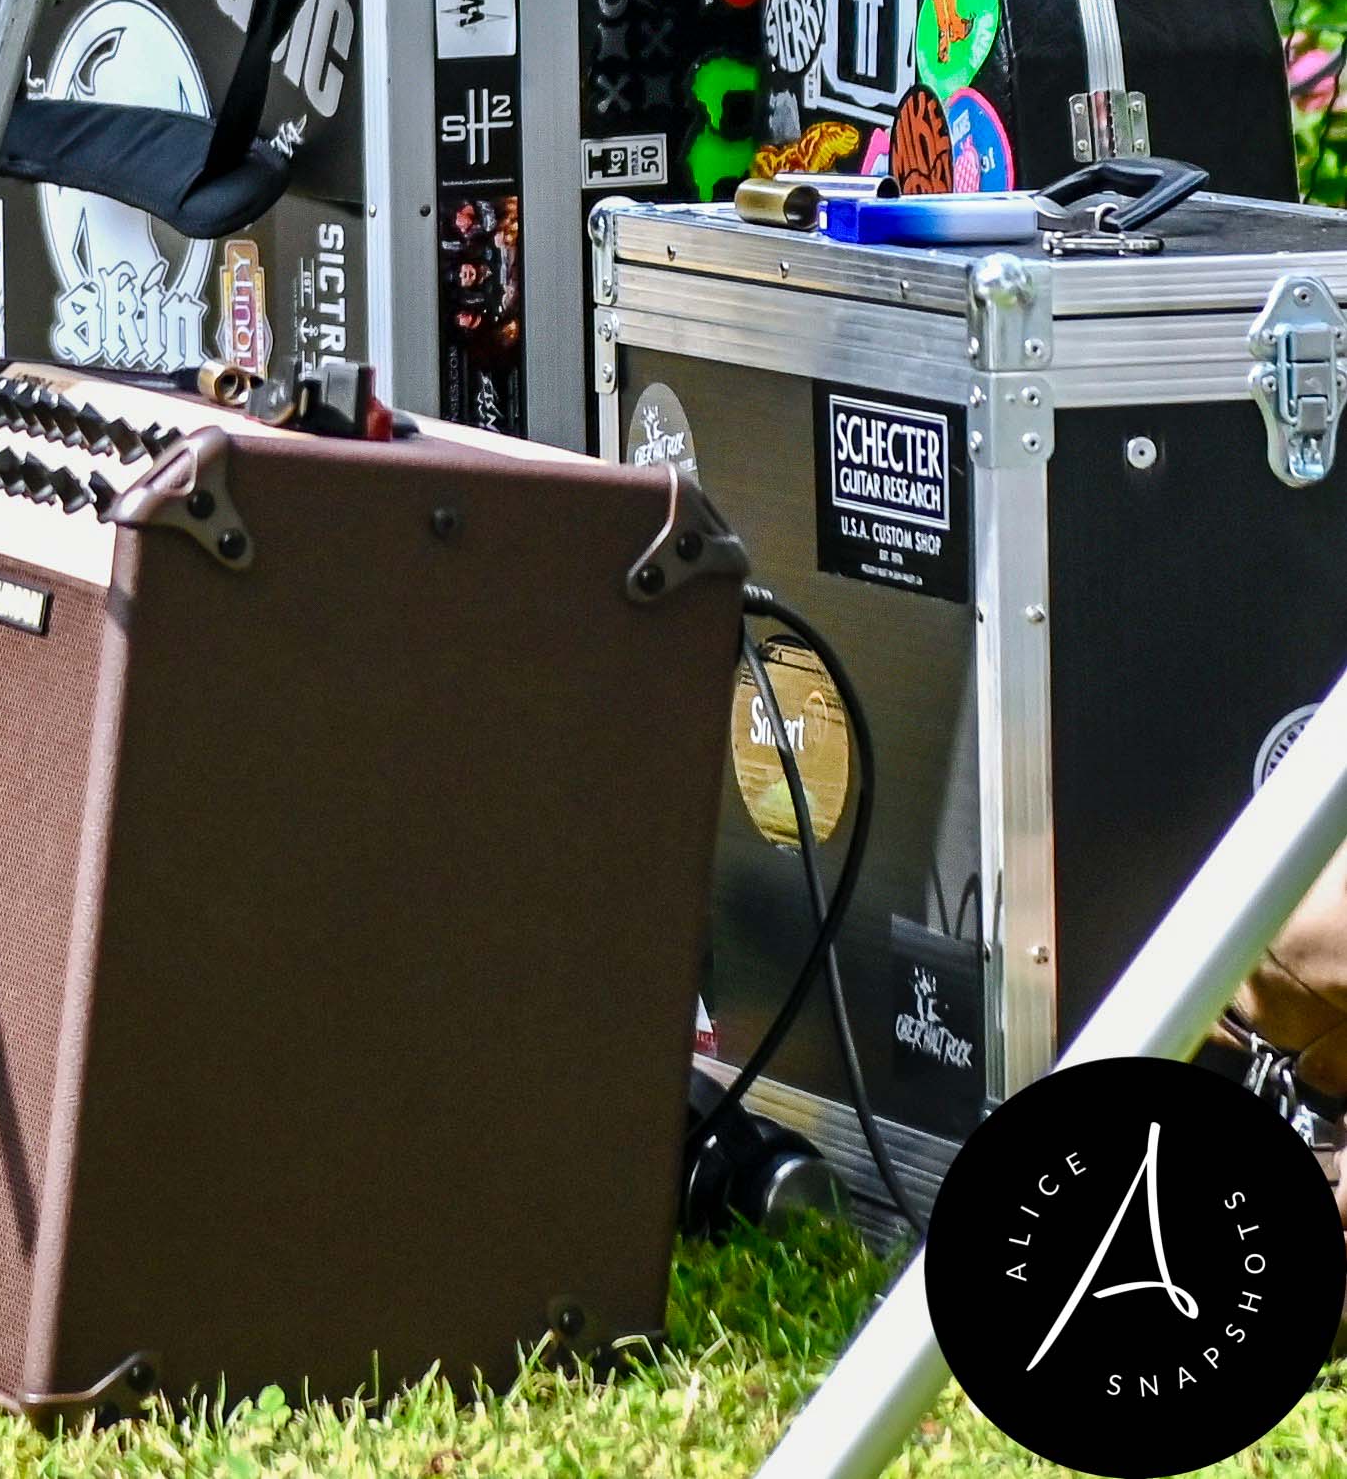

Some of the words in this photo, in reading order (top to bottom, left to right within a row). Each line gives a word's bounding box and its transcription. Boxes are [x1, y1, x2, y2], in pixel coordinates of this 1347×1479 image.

[608, 150, 625, 174] kg
[641, 146, 659, 174] 50
[836, 412, 943, 479] SCHECTER
[839, 466, 883, 501] GUITAR
[883, 475, 941, 512] RESEARCH
[840, 515, 871, 539] U.S.A.
[872, 522, 914, 550] CUSTOM
[914, 530, 942, 556] SHOP
